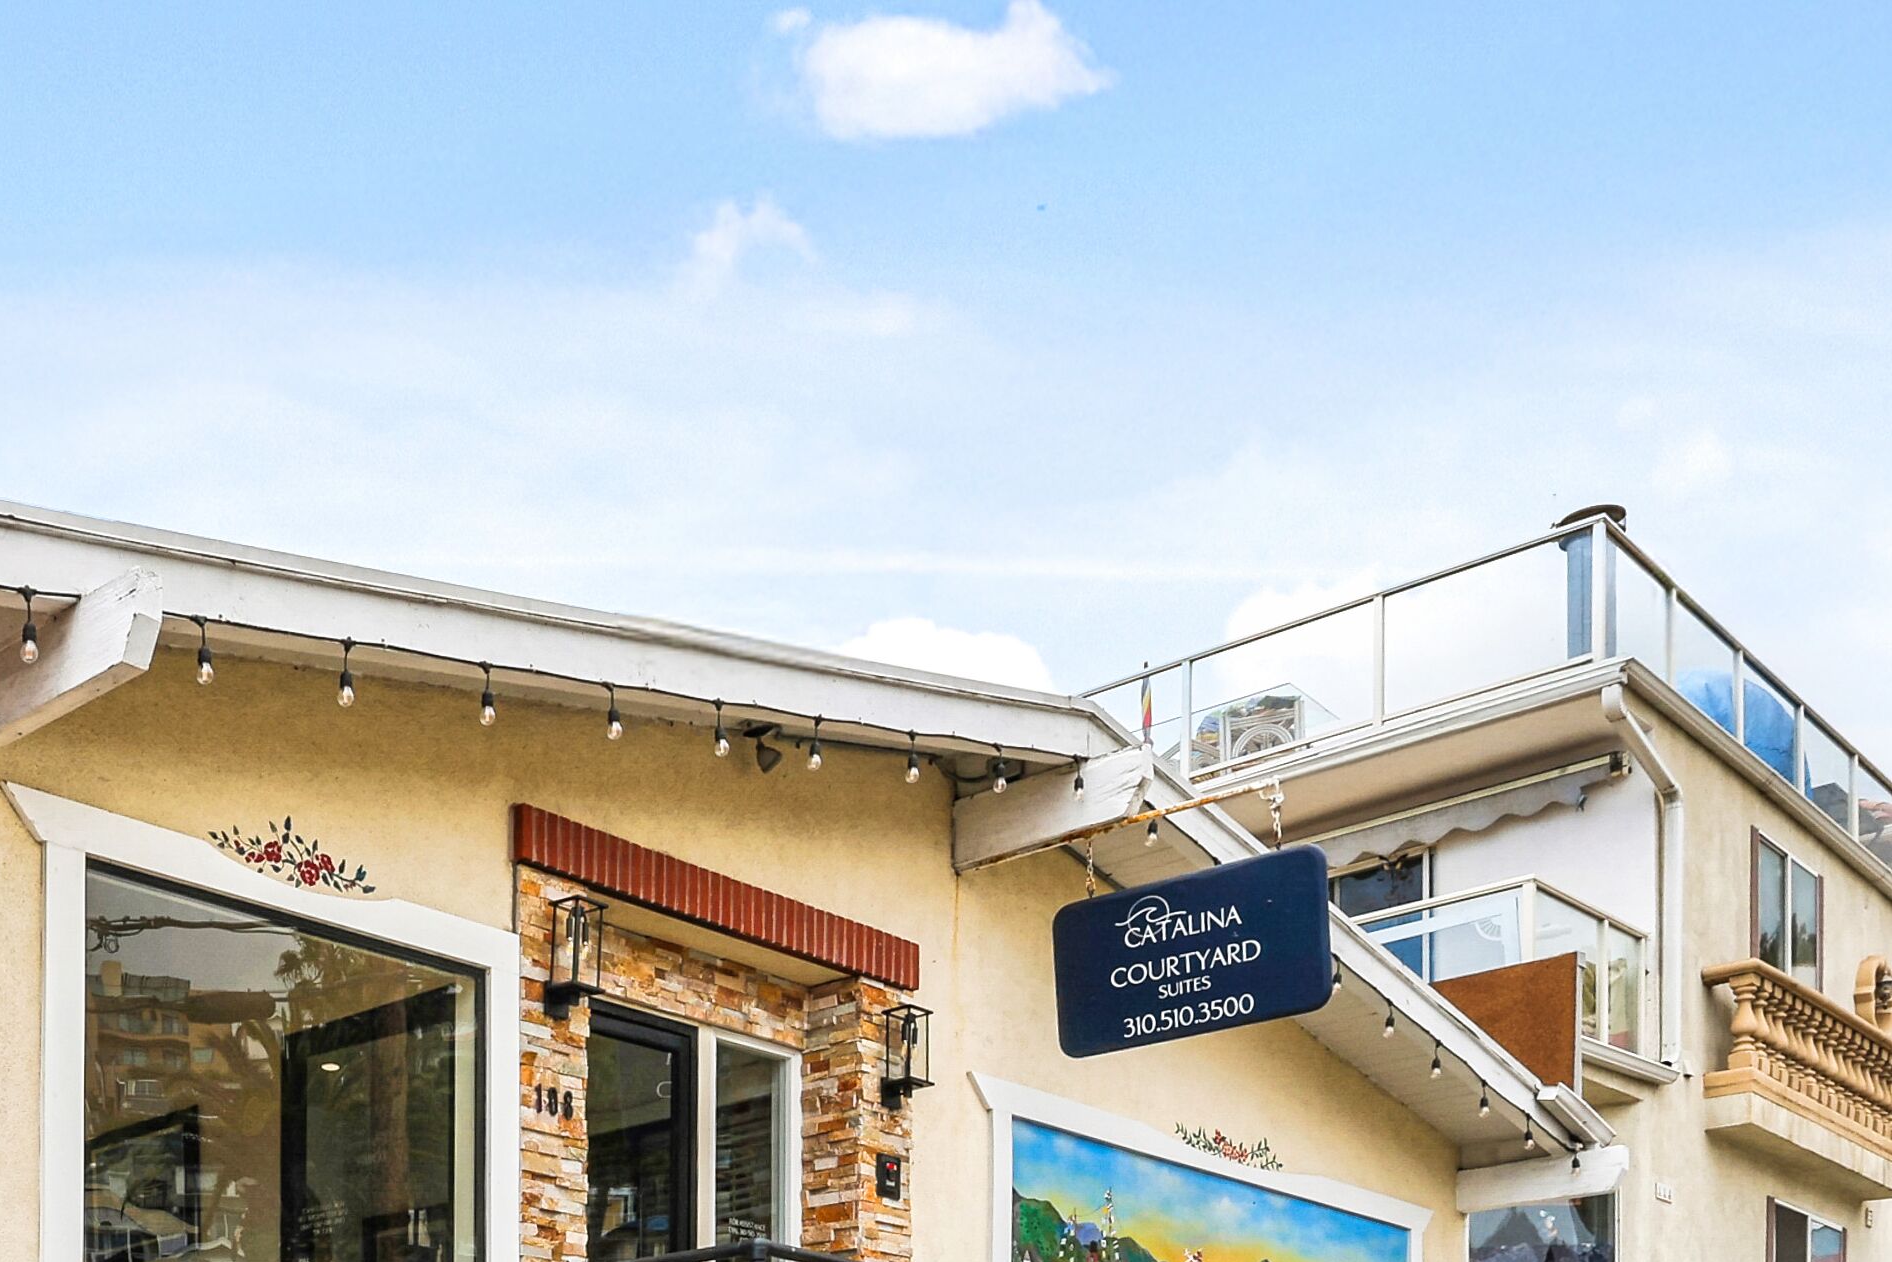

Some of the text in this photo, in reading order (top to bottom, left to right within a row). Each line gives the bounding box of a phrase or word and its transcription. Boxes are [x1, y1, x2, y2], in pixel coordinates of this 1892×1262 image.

[1124, 905, 1243, 948] CATALINA
[1110, 939, 1262, 988] COURTYARD
[1158, 975, 1212, 999] SUITES
[1123, 993, 1255, 1038] 310.510.3500
[535, 1083, 573, 1120] 108
